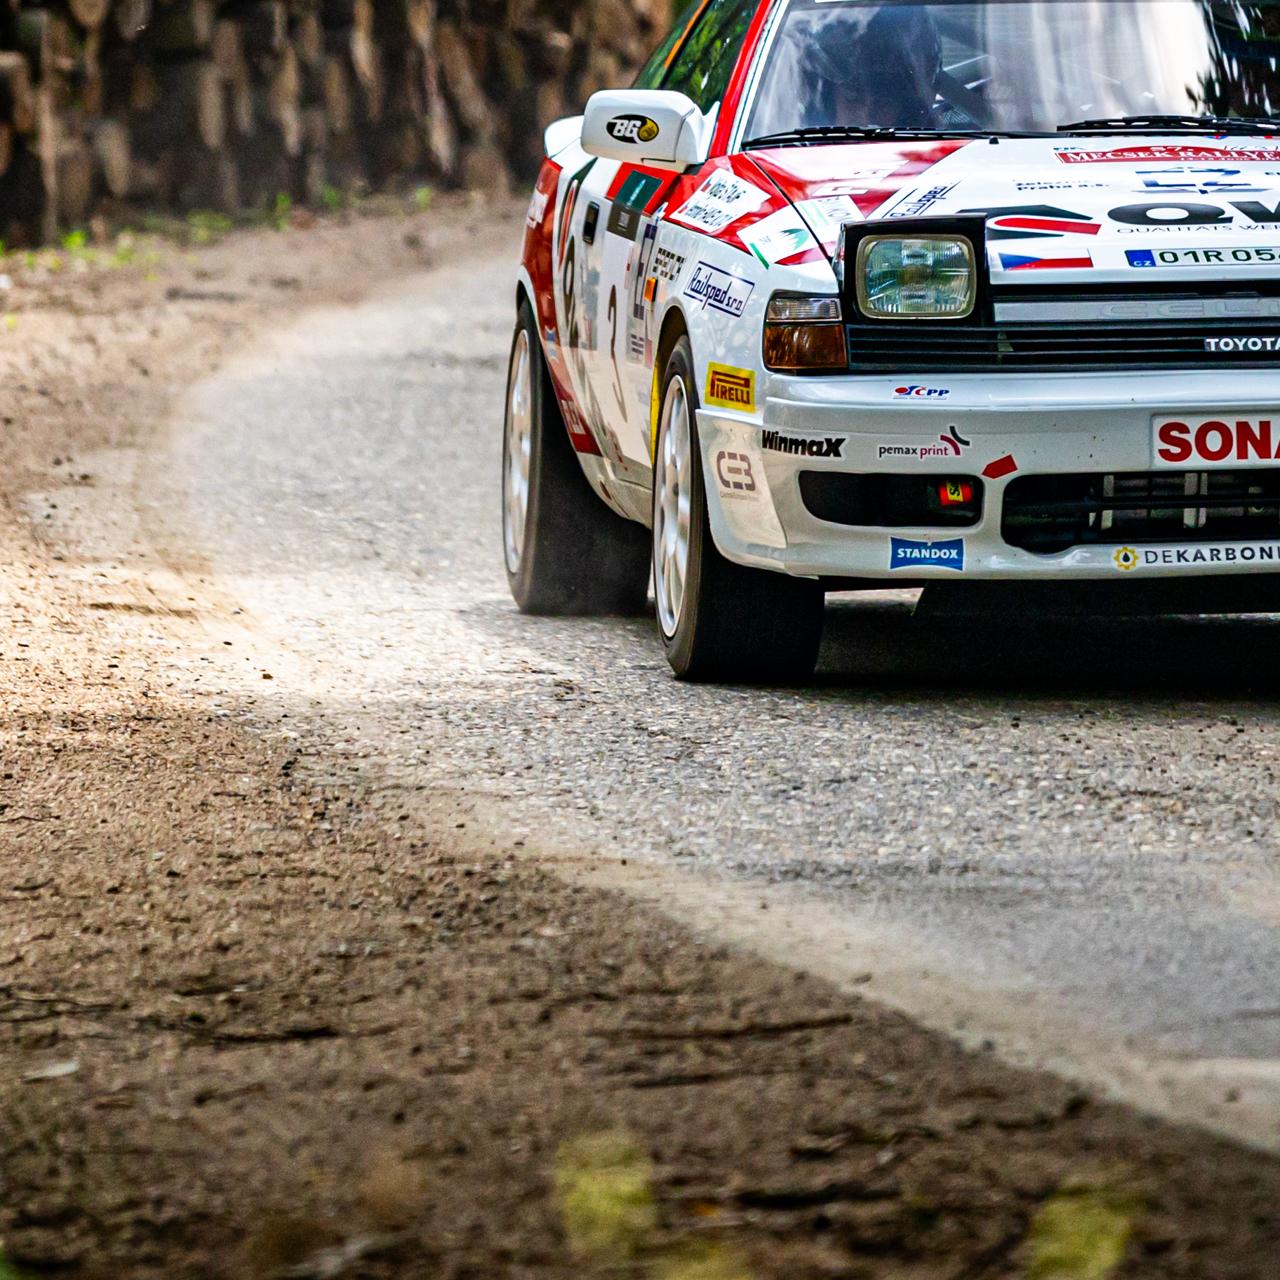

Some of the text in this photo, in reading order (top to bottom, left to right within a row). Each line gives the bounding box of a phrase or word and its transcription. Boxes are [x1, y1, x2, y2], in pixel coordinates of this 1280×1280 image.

[1066, 151, 1174, 162] MECSEK
[1178, 150, 1280, 161] RALLYE
[1158, 250, 1224, 264] 01R
[709, 370, 751, 405] PIRELLI
[878, 443, 950, 460] pemax print
[896, 547, 960, 560] STANDOX
